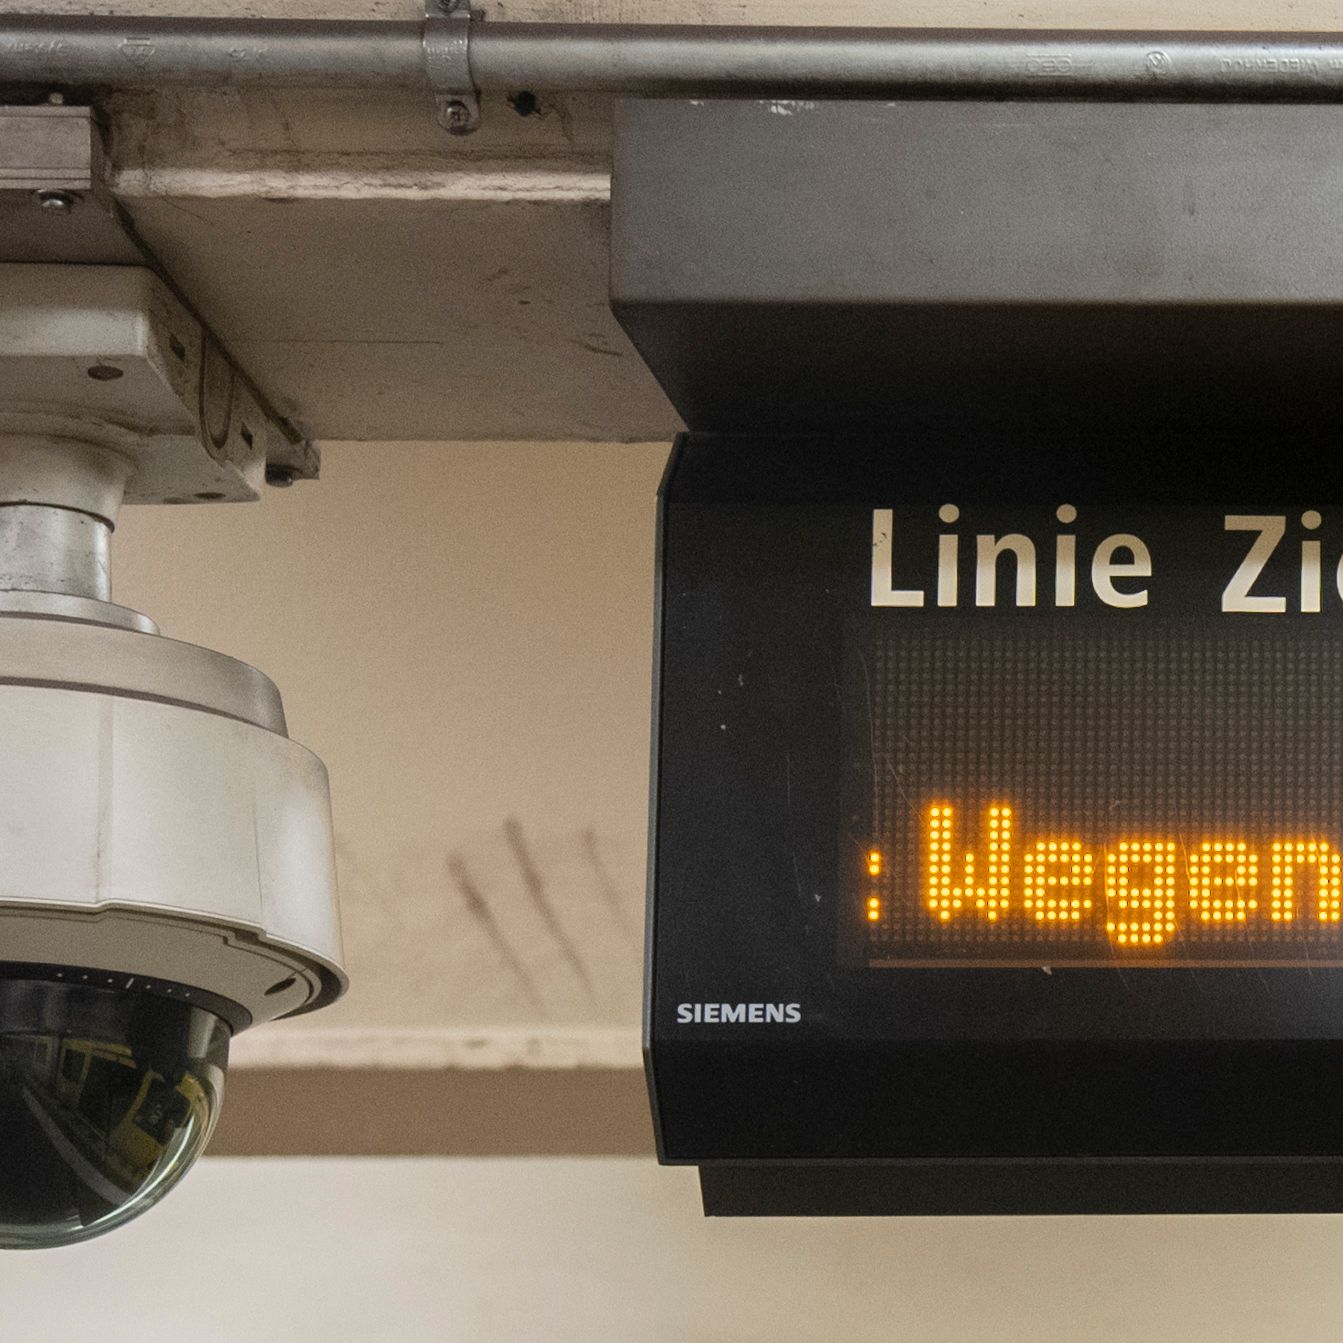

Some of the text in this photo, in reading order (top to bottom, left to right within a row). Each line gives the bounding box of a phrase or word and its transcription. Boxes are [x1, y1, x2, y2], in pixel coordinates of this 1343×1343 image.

[870, 503, 1153, 609] Linie
[925, 803, 1343, 946] Wegen
[676, 1002, 802, 1024] SIEMENS
